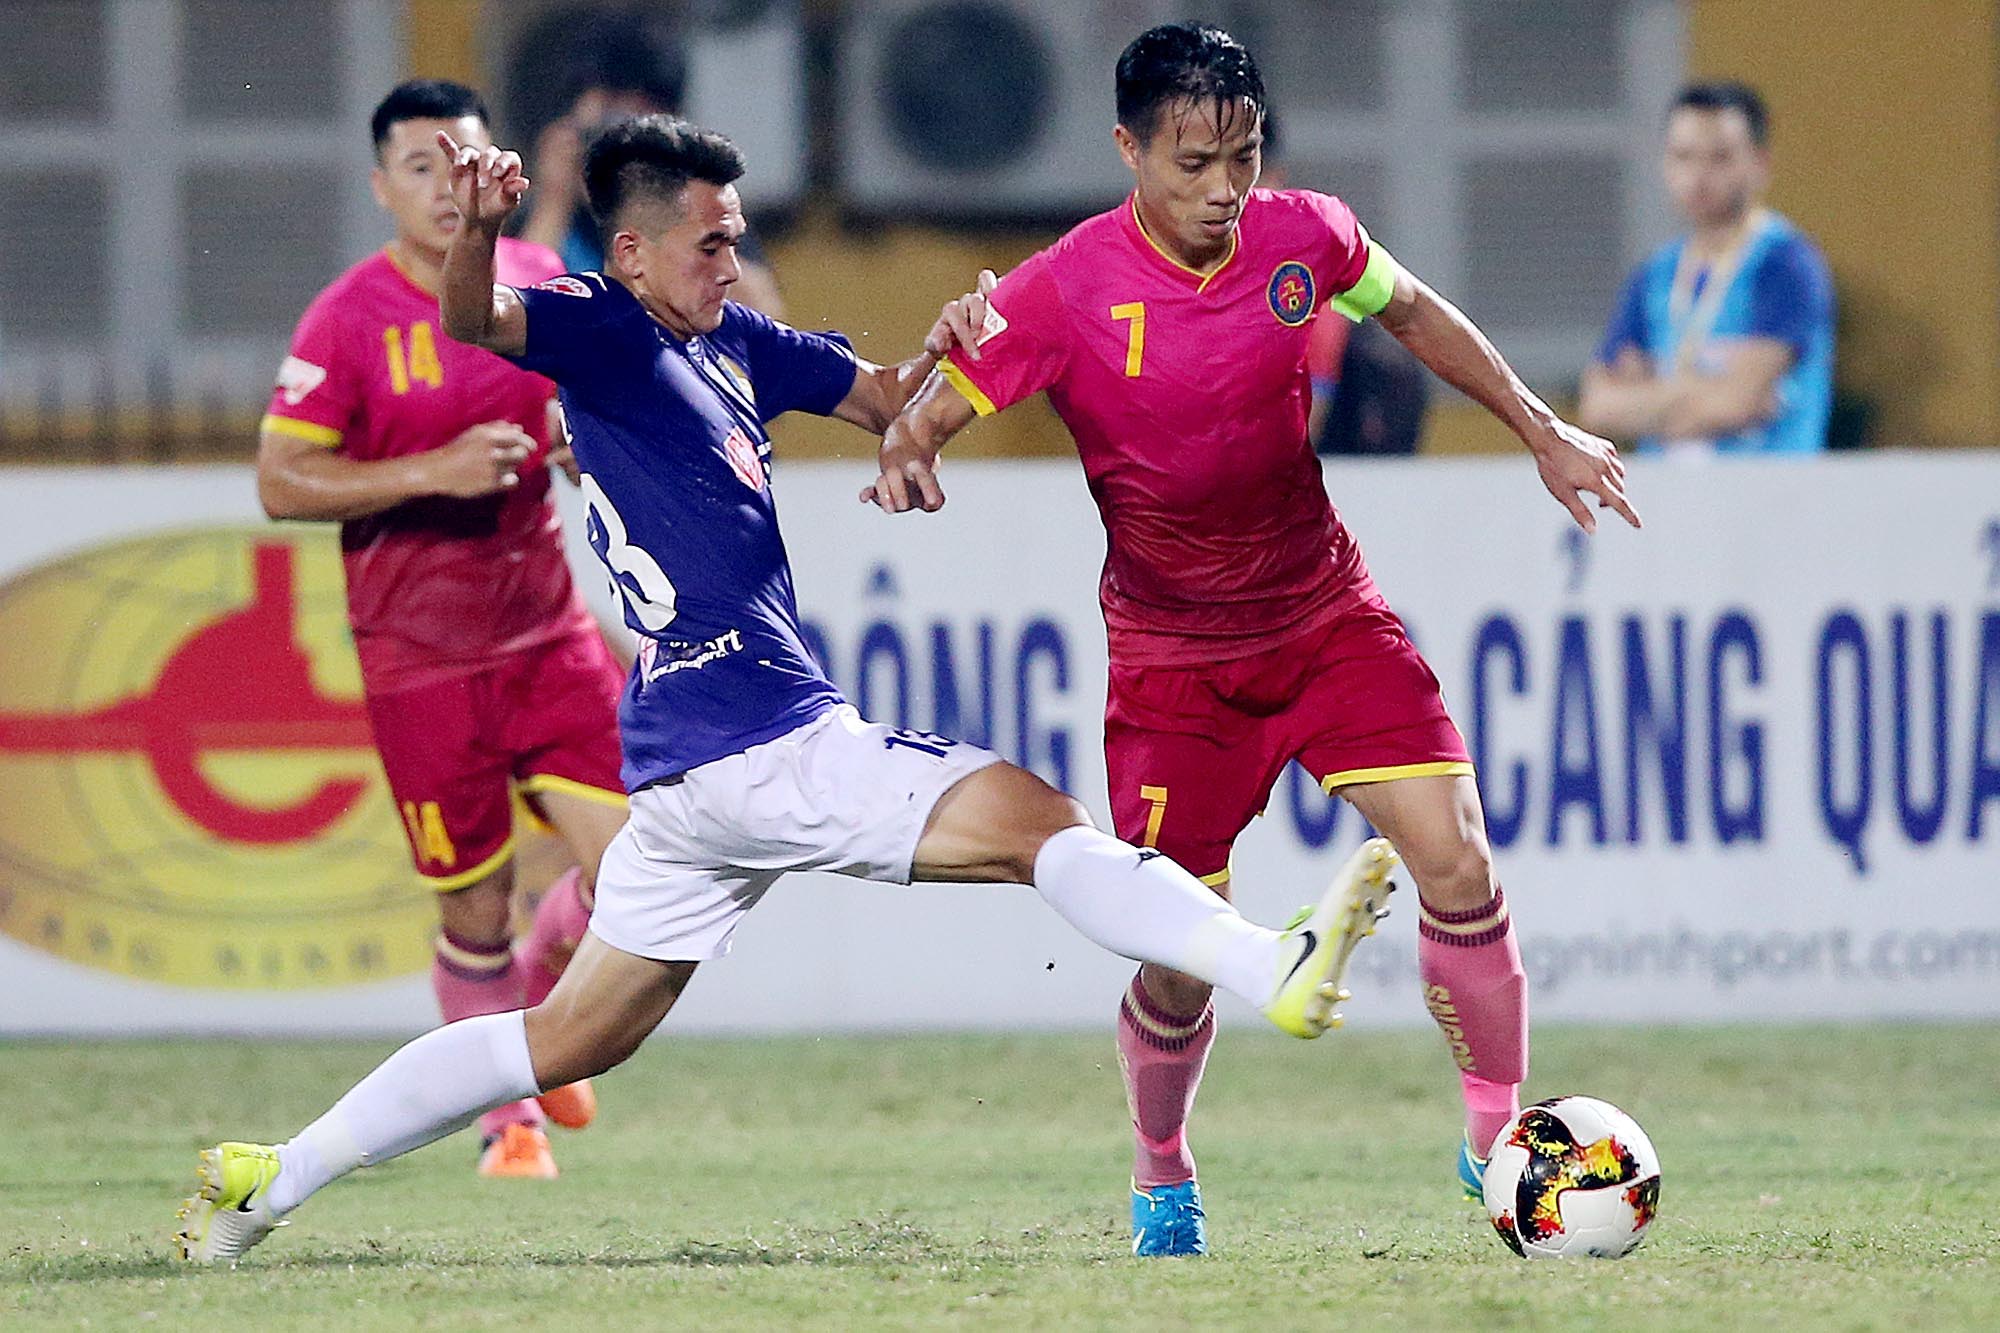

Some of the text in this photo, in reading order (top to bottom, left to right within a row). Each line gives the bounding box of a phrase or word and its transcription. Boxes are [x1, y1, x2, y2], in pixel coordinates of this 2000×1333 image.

[384, 322, 443, 396] 14
[1110, 301, 1145, 377] 7
[1472, 520, 1767, 849] CẢNG
[402, 800, 458, 868] 14
[1140, 785, 1168, 848] 7
